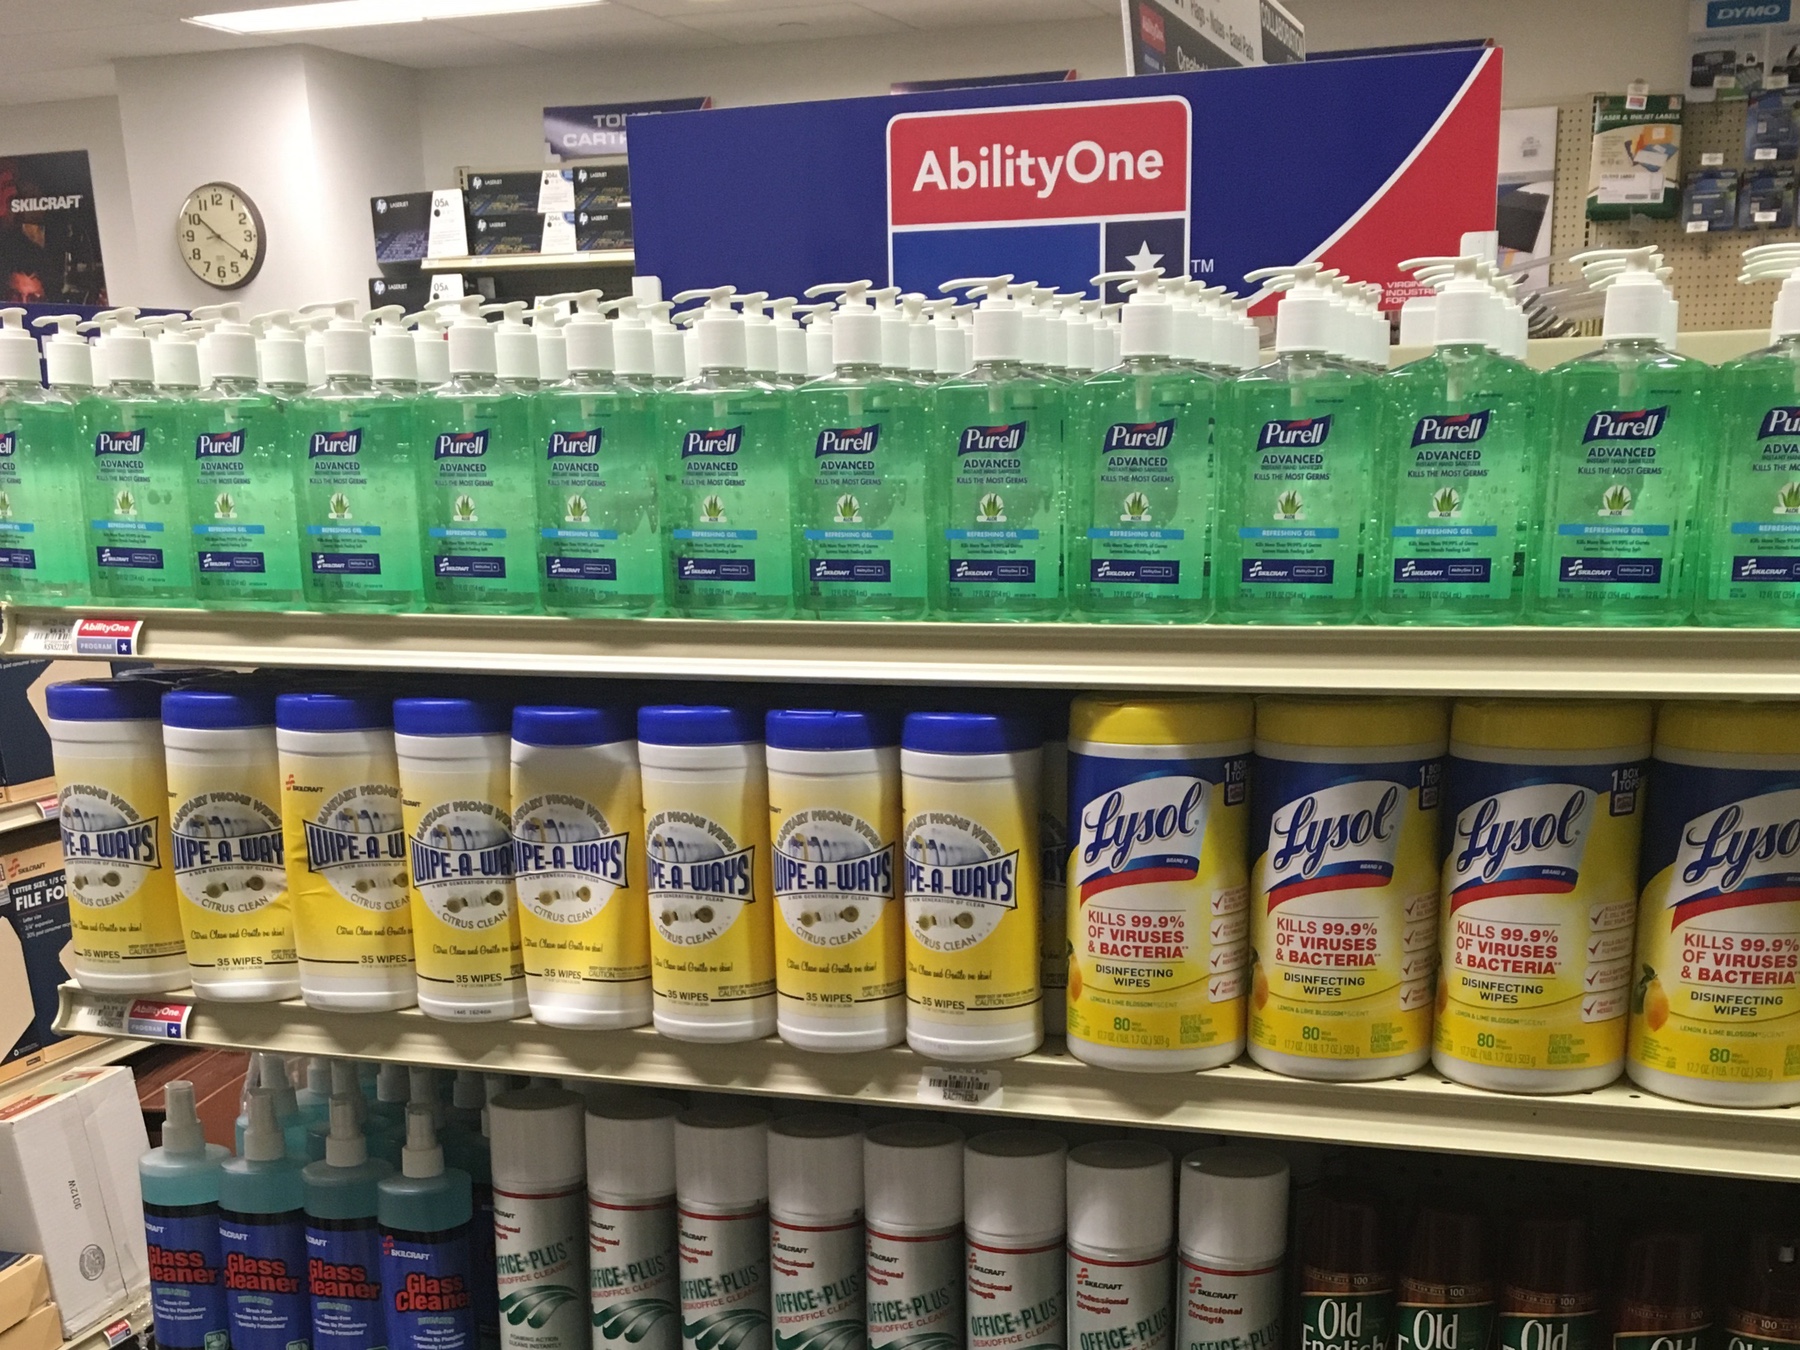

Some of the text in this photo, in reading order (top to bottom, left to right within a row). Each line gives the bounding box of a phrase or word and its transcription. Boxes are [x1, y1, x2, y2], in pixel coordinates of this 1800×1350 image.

[1717, 4, 1780, 19] DYMO
[912, 140, 1164, 199] AbilityOne
[11, 195, 81, 213] SKILCRAFT
[199, 200, 207, 211] 11
[211, 194, 222, 206] 12
[230, 200, 234, 211] 1
[434, 198, 449, 208] 05A
[188, 214, 200, 225] 10
[238, 213, 247, 225] 2
[186, 230, 195, 242] 9
[244, 230, 253, 241] 3
[192, 249, 201, 260] 8
[240, 249, 249, 260] 4
[203, 261, 211, 273] 7
[217, 266, 226, 278] 6
[231, 262, 239, 273] 5
[1192, 258, 1214, 273] TM
[1420, 418, 1481, 440] Purell
[1593, 414, 1659, 437] Purell
[966, 429, 1020, 449] Purell
[1111, 426, 1168, 448] Purell
[1265, 422, 1324, 444] Purell
[100, 433, 140, 452] Purell
[200, 435, 240, 454] Purell
[553, 434, 597, 454] Purell
[822, 431, 873, 452] Purell
[1262, 454, 1324, 464] ADVANCED
[1416, 450, 1481, 461] ADVANCED
[1588, 447, 1656, 457] ADVANCED
[821, 461, 875, 470] ADVANCED
[1108, 456, 1168, 466] ADVANCED
[81, 622, 131, 634] AbilityOne
[80, 642, 112, 650] PROGRAM
[1622, 767, 1640, 779] BOX
[811, 810, 854, 826] PHONE
[1084, 782, 1202, 869] Lysol
[1274, 786, 1398, 875] Lysol
[1457, 789, 1586, 879] Lysol
[309, 826, 407, 867] WIPE-A-W
[1682, 804, 1800, 889] Lyso
[18, 862, 46, 875] SKILCRAFT
[773, 851, 891, 894] WIPE-A-WAYS
[12, 884, 33, 895] LETTER
[16, 892, 42, 912] FILE
[534, 905, 593, 924] CITRUS CLEAN
[1088, 910, 1185, 928] KILLS 99.9%
[1277, 917, 1377, 936] KILLS 99.9%
[1457, 920, 1559, 944] KILLS 99.9%
[796, 926, 862, 946] CITRUS CLEAN
[1088, 925, 1185, 943] OF VIRUSES
[1088, 940, 1095, 953] &
[1276, 933, 1377, 951] OF VIRUSES
[1456, 936, 1558, 959] OF VIRUSES
[1684, 932, 1800, 952] KILLS 99.9%
[217, 956, 263, 967] 35 WIPES
[361, 954, 407, 964] 35 WIPES
[1275, 948, 1284, 961] &
[1455, 952, 1463, 965] &
[1682, 949, 1798, 969] OF VIRUSES
[1095, 964, 1174, 978] DISINFECTING
[1681, 965, 1691, 979] &
[1113, 977, 1151, 988] WIPES
[1462, 977, 1544, 995] DISINFECTING
[806, 992, 853, 1003] 35 WIPES
[922, 996, 965, 1010] 35 WIPES
[1479, 991, 1519, 1004] WIPES
[1690, 991, 1784, 1005] DISINFECTING
[133, 1005, 180, 1017] AbilityOne
[1713, 1005, 1758, 1017] WIPES
[131, 1024, 162, 1033] PROGRAM
[1113, 1017, 1130, 1031] 80
[1302, 1026, 1320, 1041] 80
[1477, 1032, 1495, 1048] 80
[1709, 1048, 1730, 1064] 80
[391, 1249, 430, 1261] SKILCRAFT
[227, 1253, 286, 1276] Glass
[309, 1259, 366, 1281] Glass
[224, 1270, 299, 1292] Cleaner
[406, 1273, 463, 1294] Glass
[1084, 1280, 1123, 1291] SKILCRAFT
[1353, 1276, 1368, 1285] 100
[1076, 1291, 1129, 1305] Professional
[1197, 1289, 1238, 1300] SKILCRAFT
[1449, 1288, 1465, 1297] 100
[396, 1291, 471, 1311] Cleaner
[1076, 1300, 1111, 1314] Strength
[1188, 1300, 1243, 1315] Professional
[1318, 1298, 1363, 1340] Old
[1761, 1319, 1777, 1329] 100
[1413, 1309, 1459, 1350] Old
